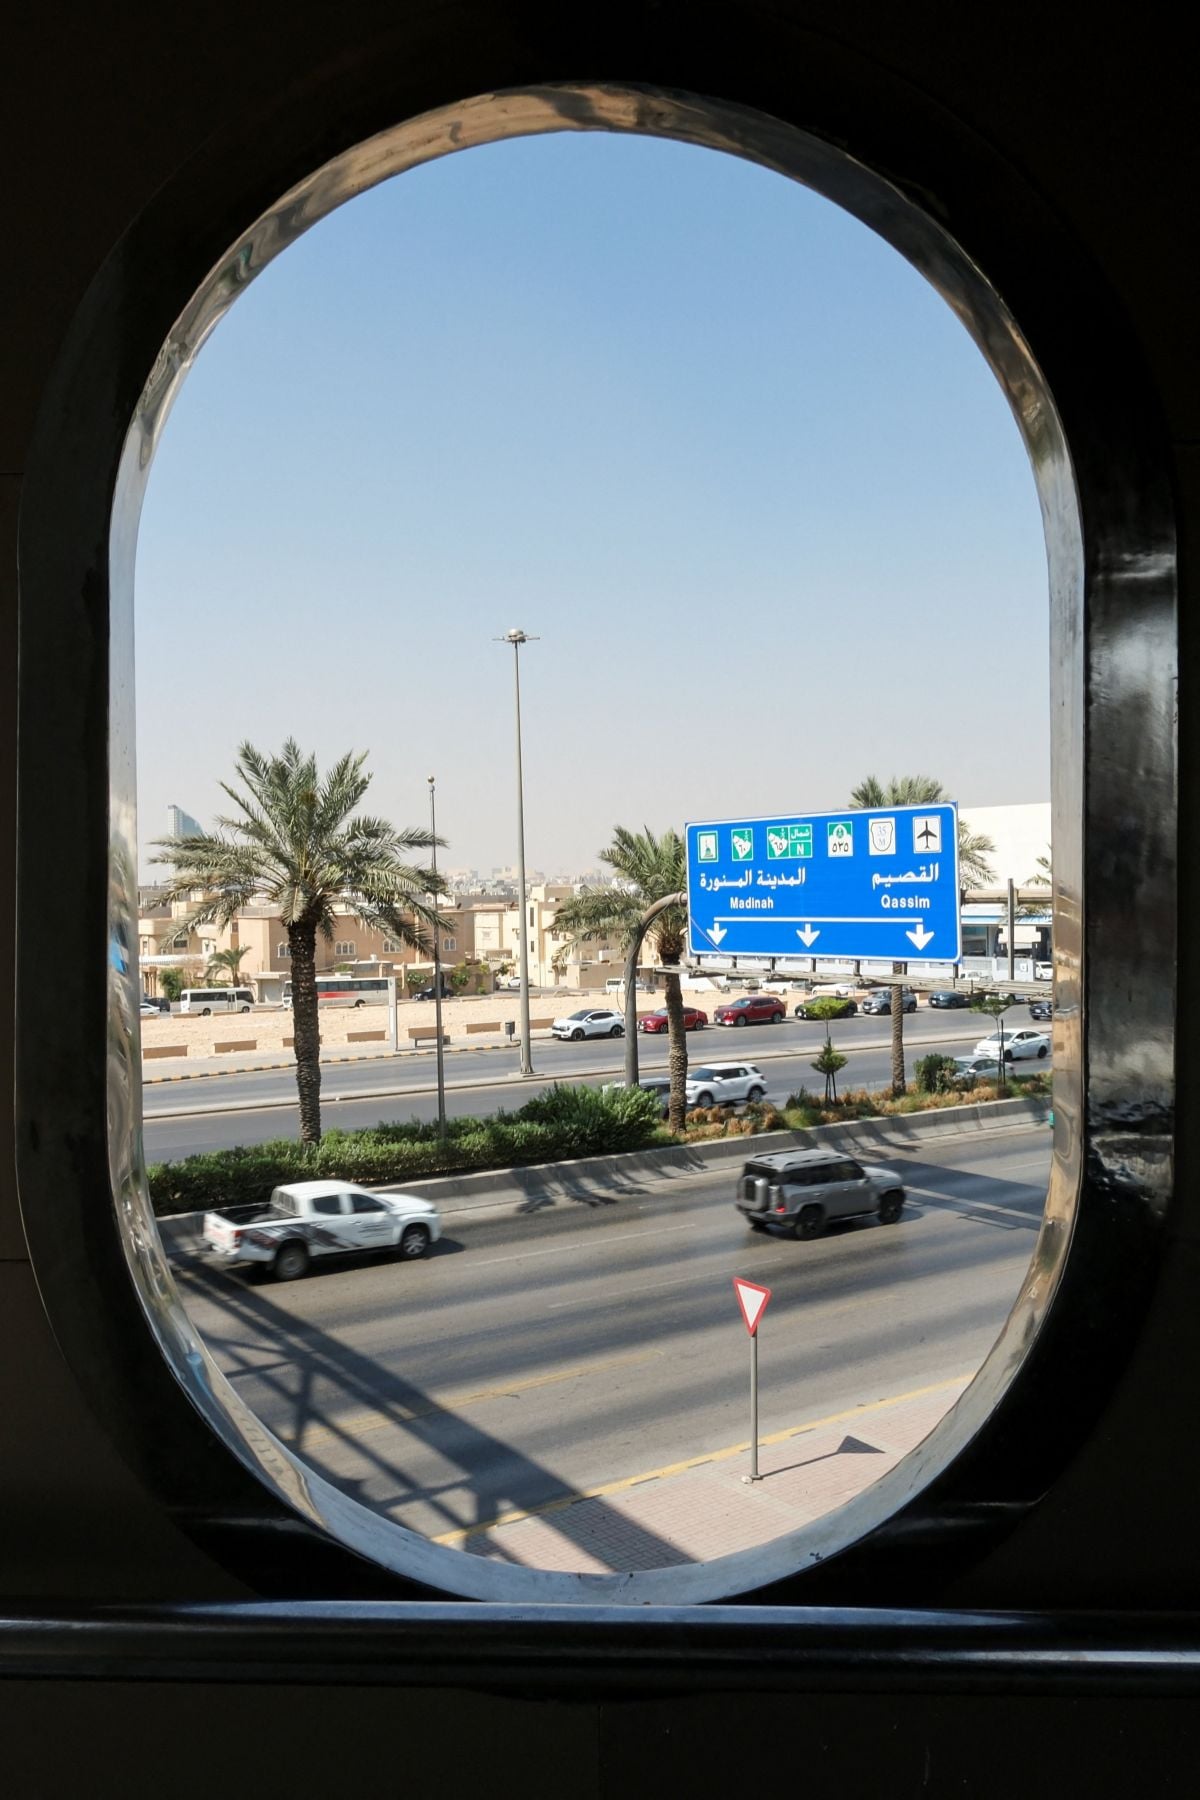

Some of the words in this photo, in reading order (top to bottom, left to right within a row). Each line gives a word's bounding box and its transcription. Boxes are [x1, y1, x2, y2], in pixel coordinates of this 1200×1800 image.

[790, 828, 810, 839] شمال
[796, 843, 805, 855] N
[700, 869, 753, 892] المنورة
[756, 867, 806, 889] المدينة
[872, 862, 939, 891] القصيم
[730, 897, 774, 909] Madinah
[881, 894, 930, 909] Qassim
